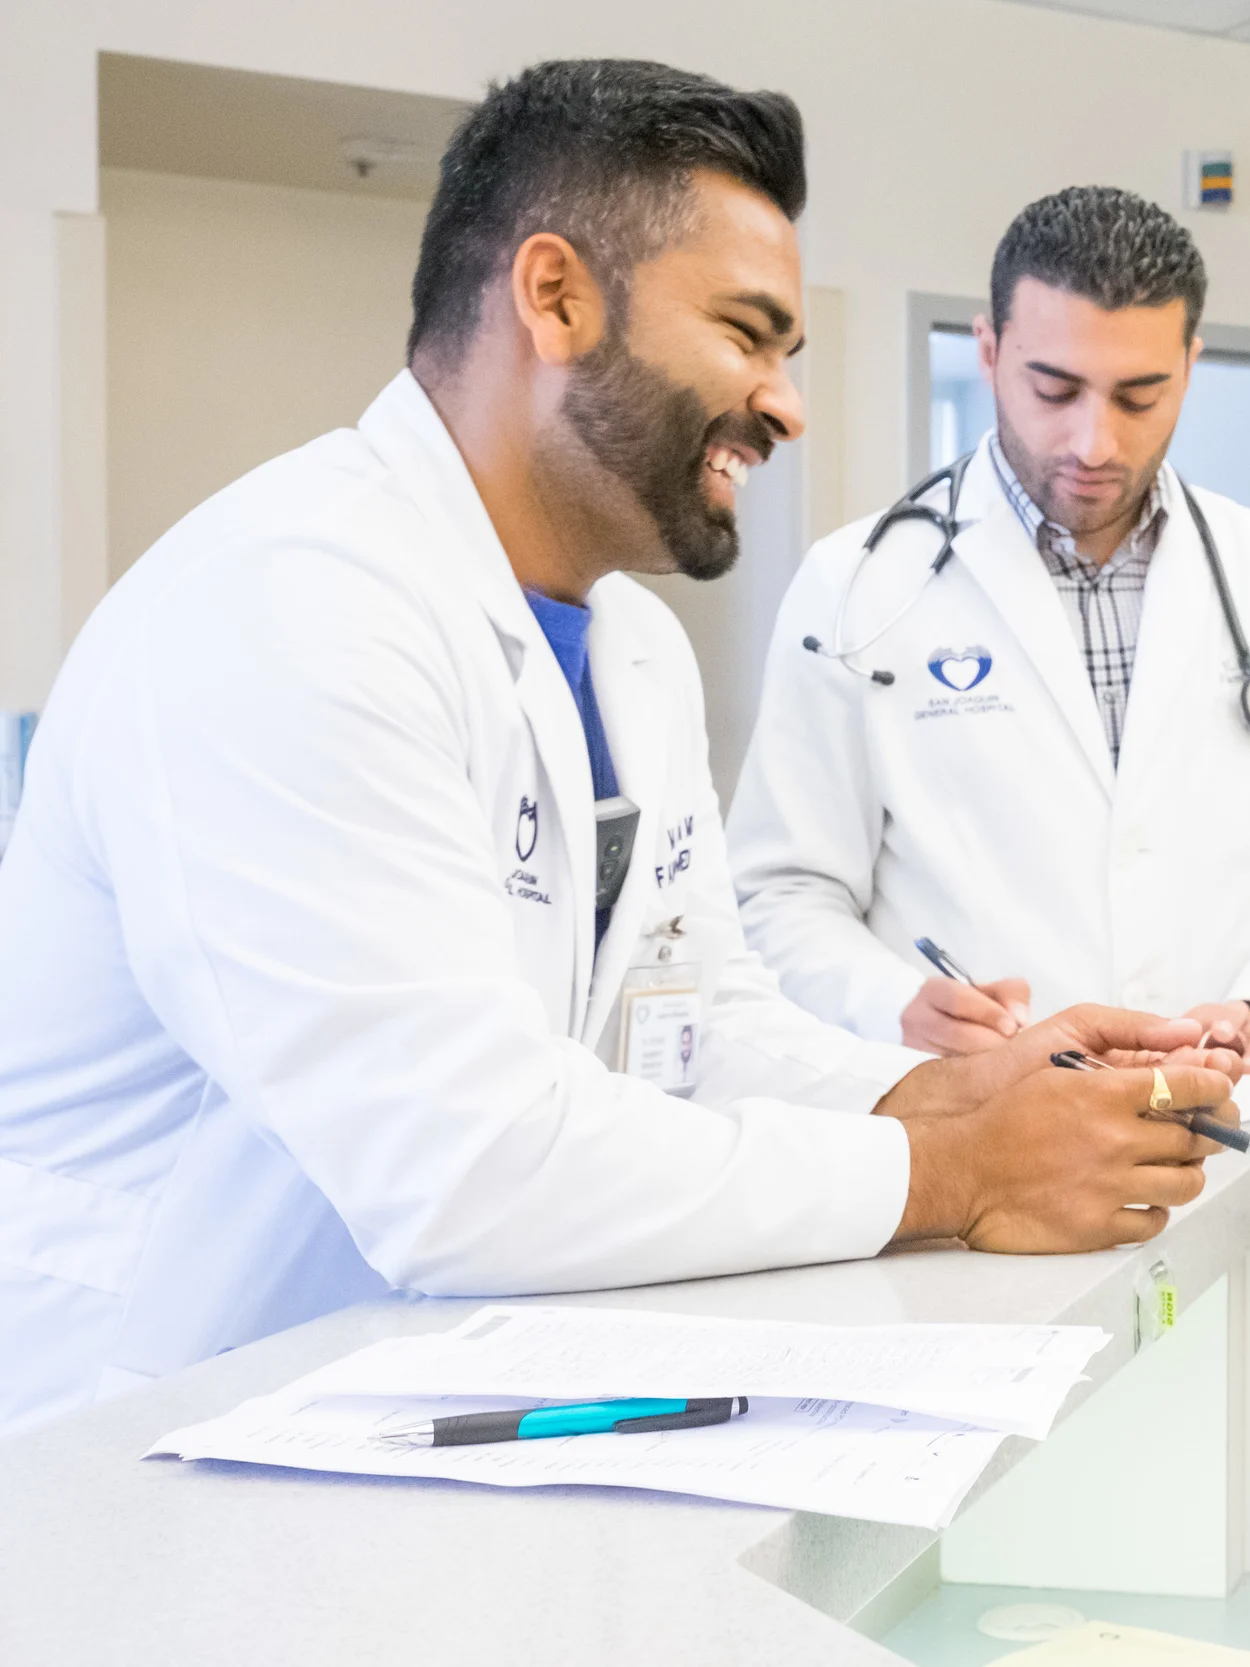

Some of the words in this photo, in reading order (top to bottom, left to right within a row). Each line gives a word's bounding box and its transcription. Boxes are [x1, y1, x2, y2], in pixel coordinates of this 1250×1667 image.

[929, 698, 950, 708] SAN
[955, 695, 999, 706] JOAQUIN
[914, 709, 959, 720] GENERAL
[965, 703, 1015, 713] HOSPITAL
